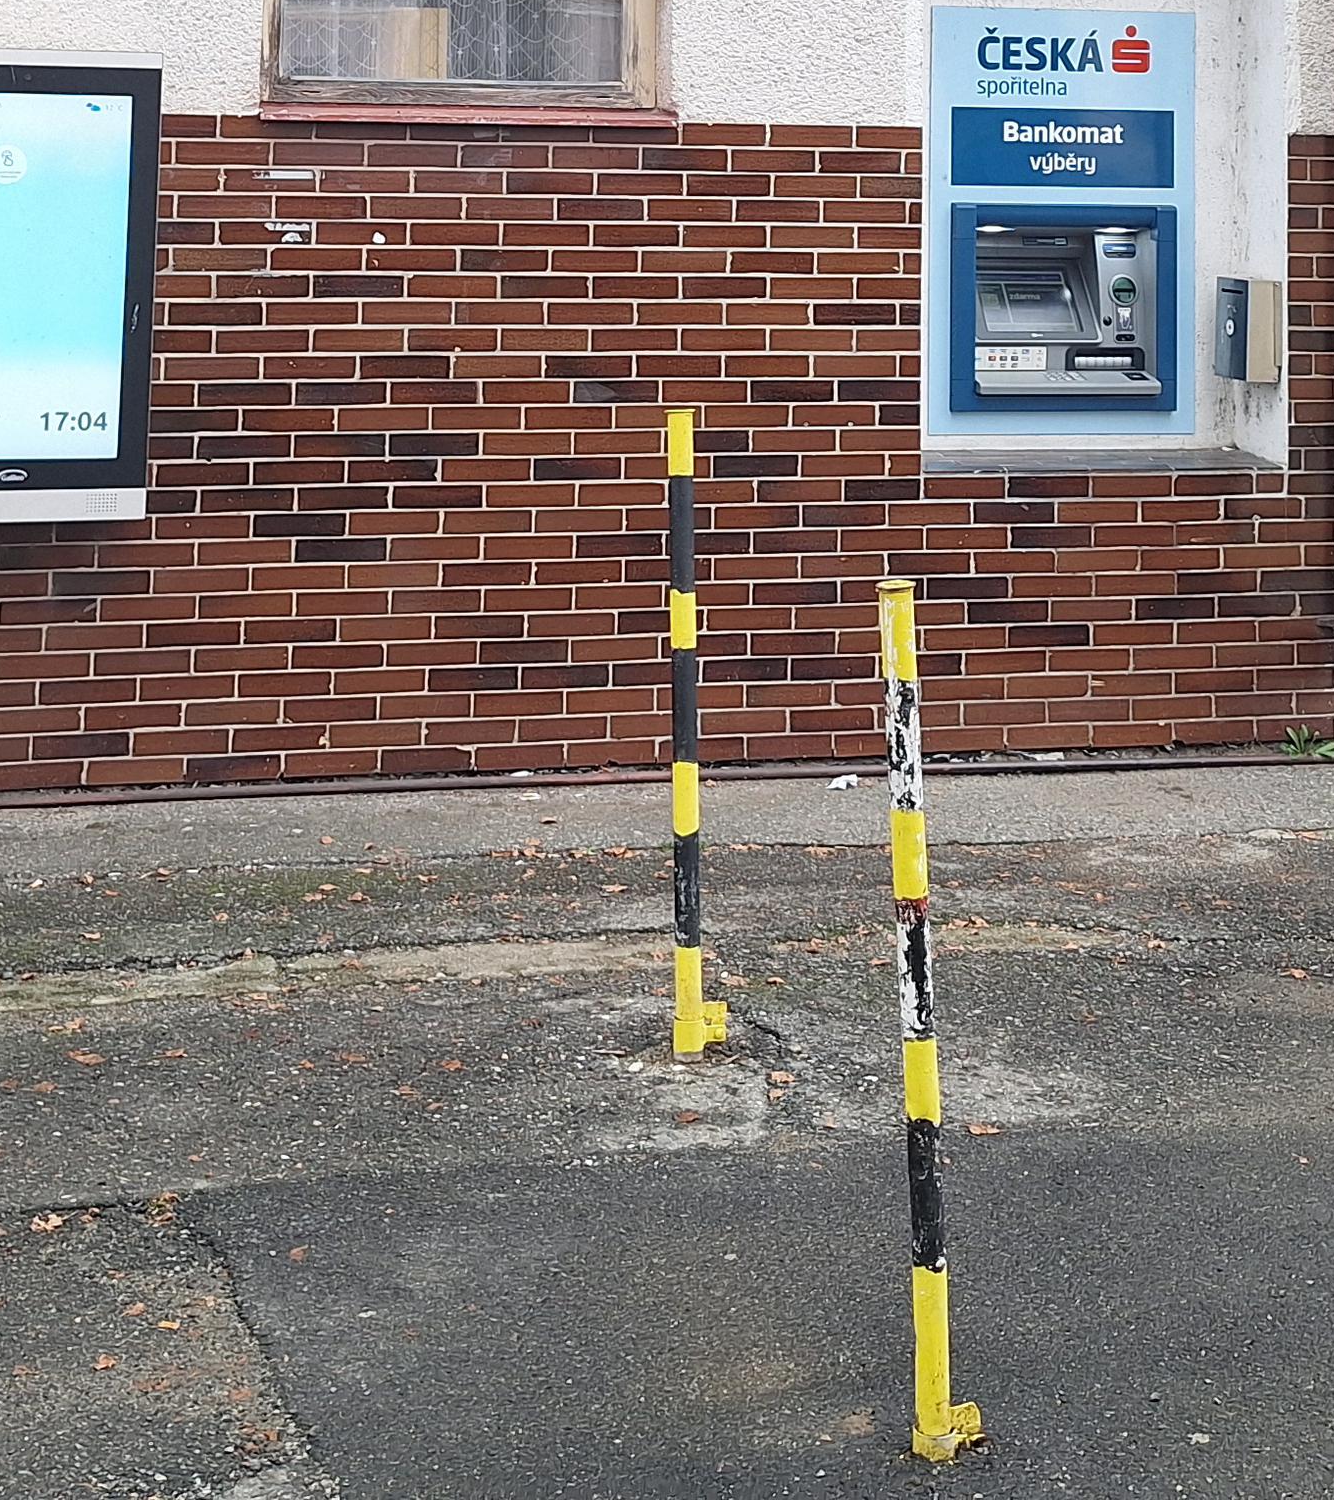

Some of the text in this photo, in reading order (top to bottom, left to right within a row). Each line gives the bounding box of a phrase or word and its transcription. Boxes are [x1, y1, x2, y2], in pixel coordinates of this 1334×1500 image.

[977, 26, 1104, 73] ČESKÁ
[977, 76, 1067, 98] spořitelna
[1003, 120, 1124, 144] Bankomat
[1029, 152, 1097, 175] výběry
[1009, 292, 1041, 301] zdarma
[40, 411, 108, 431] 17:04
